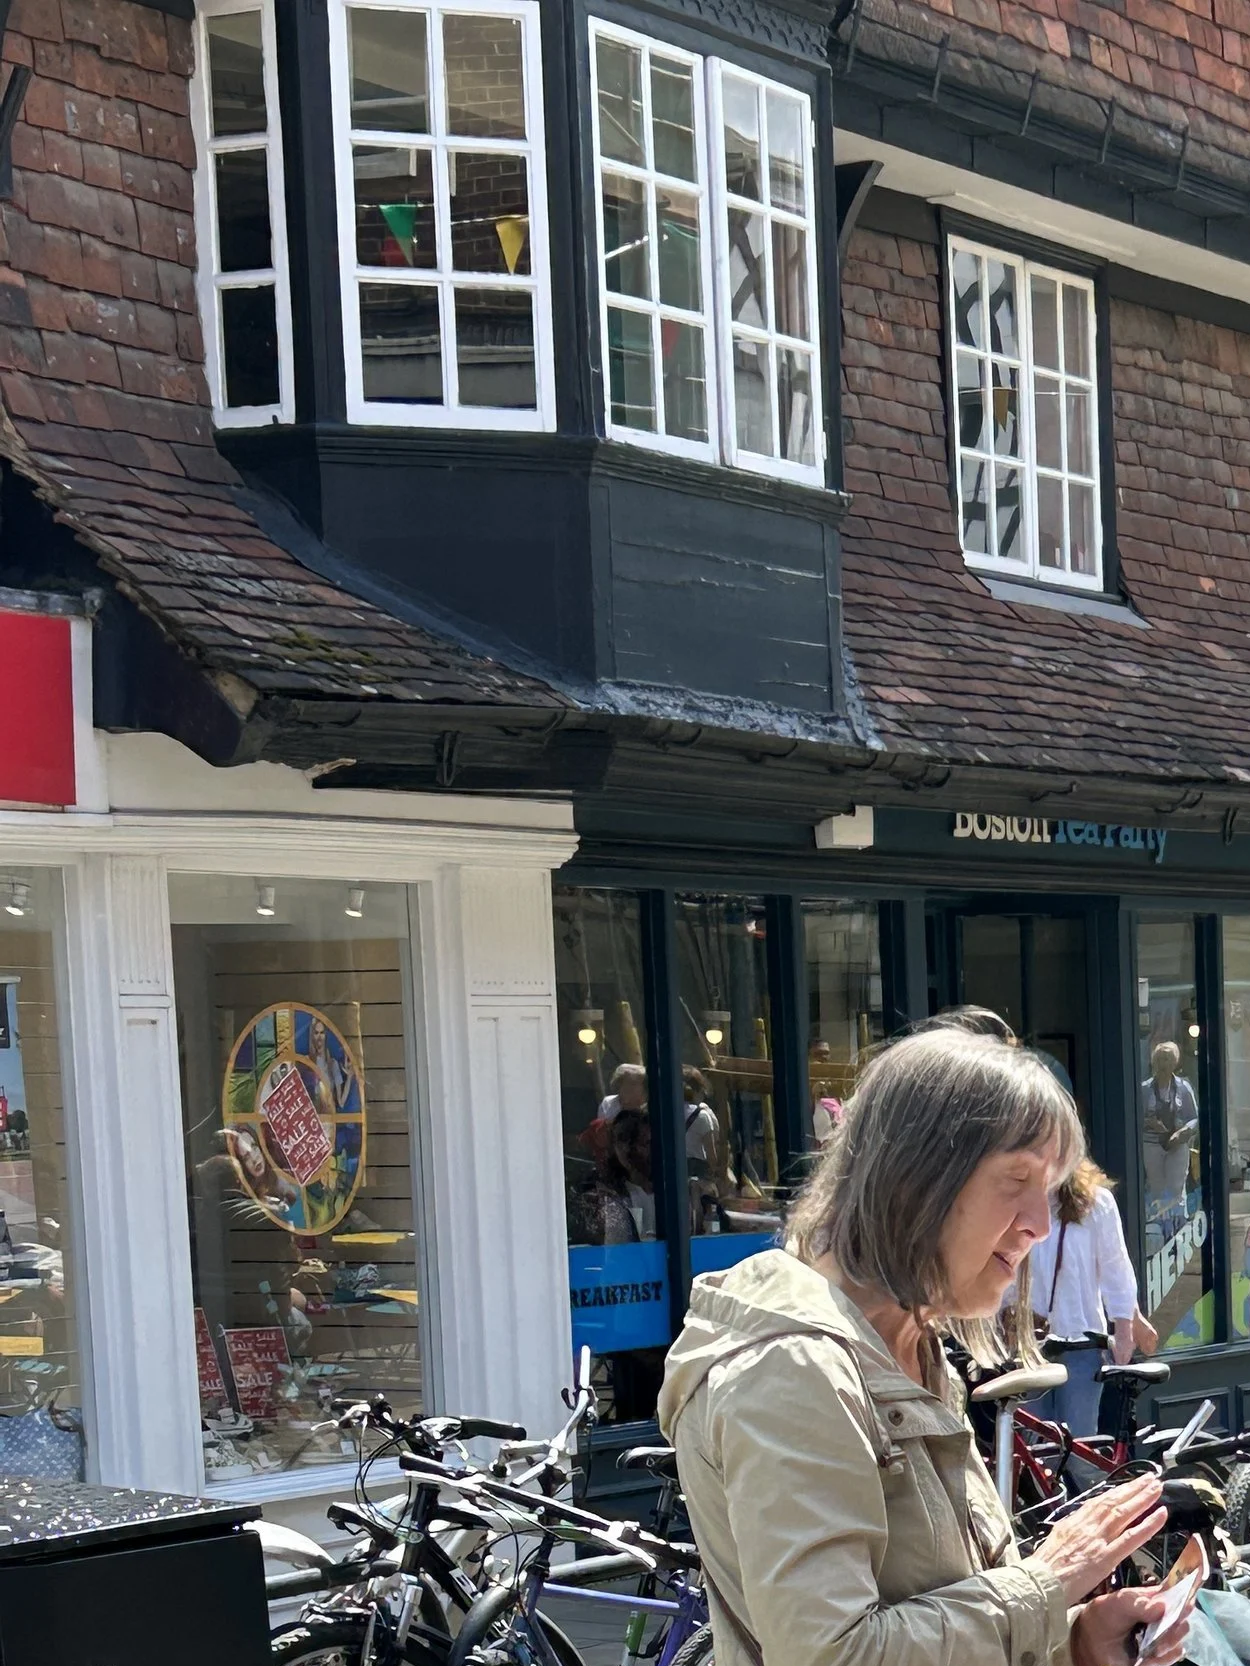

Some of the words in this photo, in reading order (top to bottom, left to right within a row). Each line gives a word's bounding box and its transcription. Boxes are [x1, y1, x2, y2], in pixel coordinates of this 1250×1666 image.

[1147, 1210, 1208, 1318] HERO
[569, 1280, 663, 1309] REAKFAST
[235, 1371, 273, 1388] SALE
